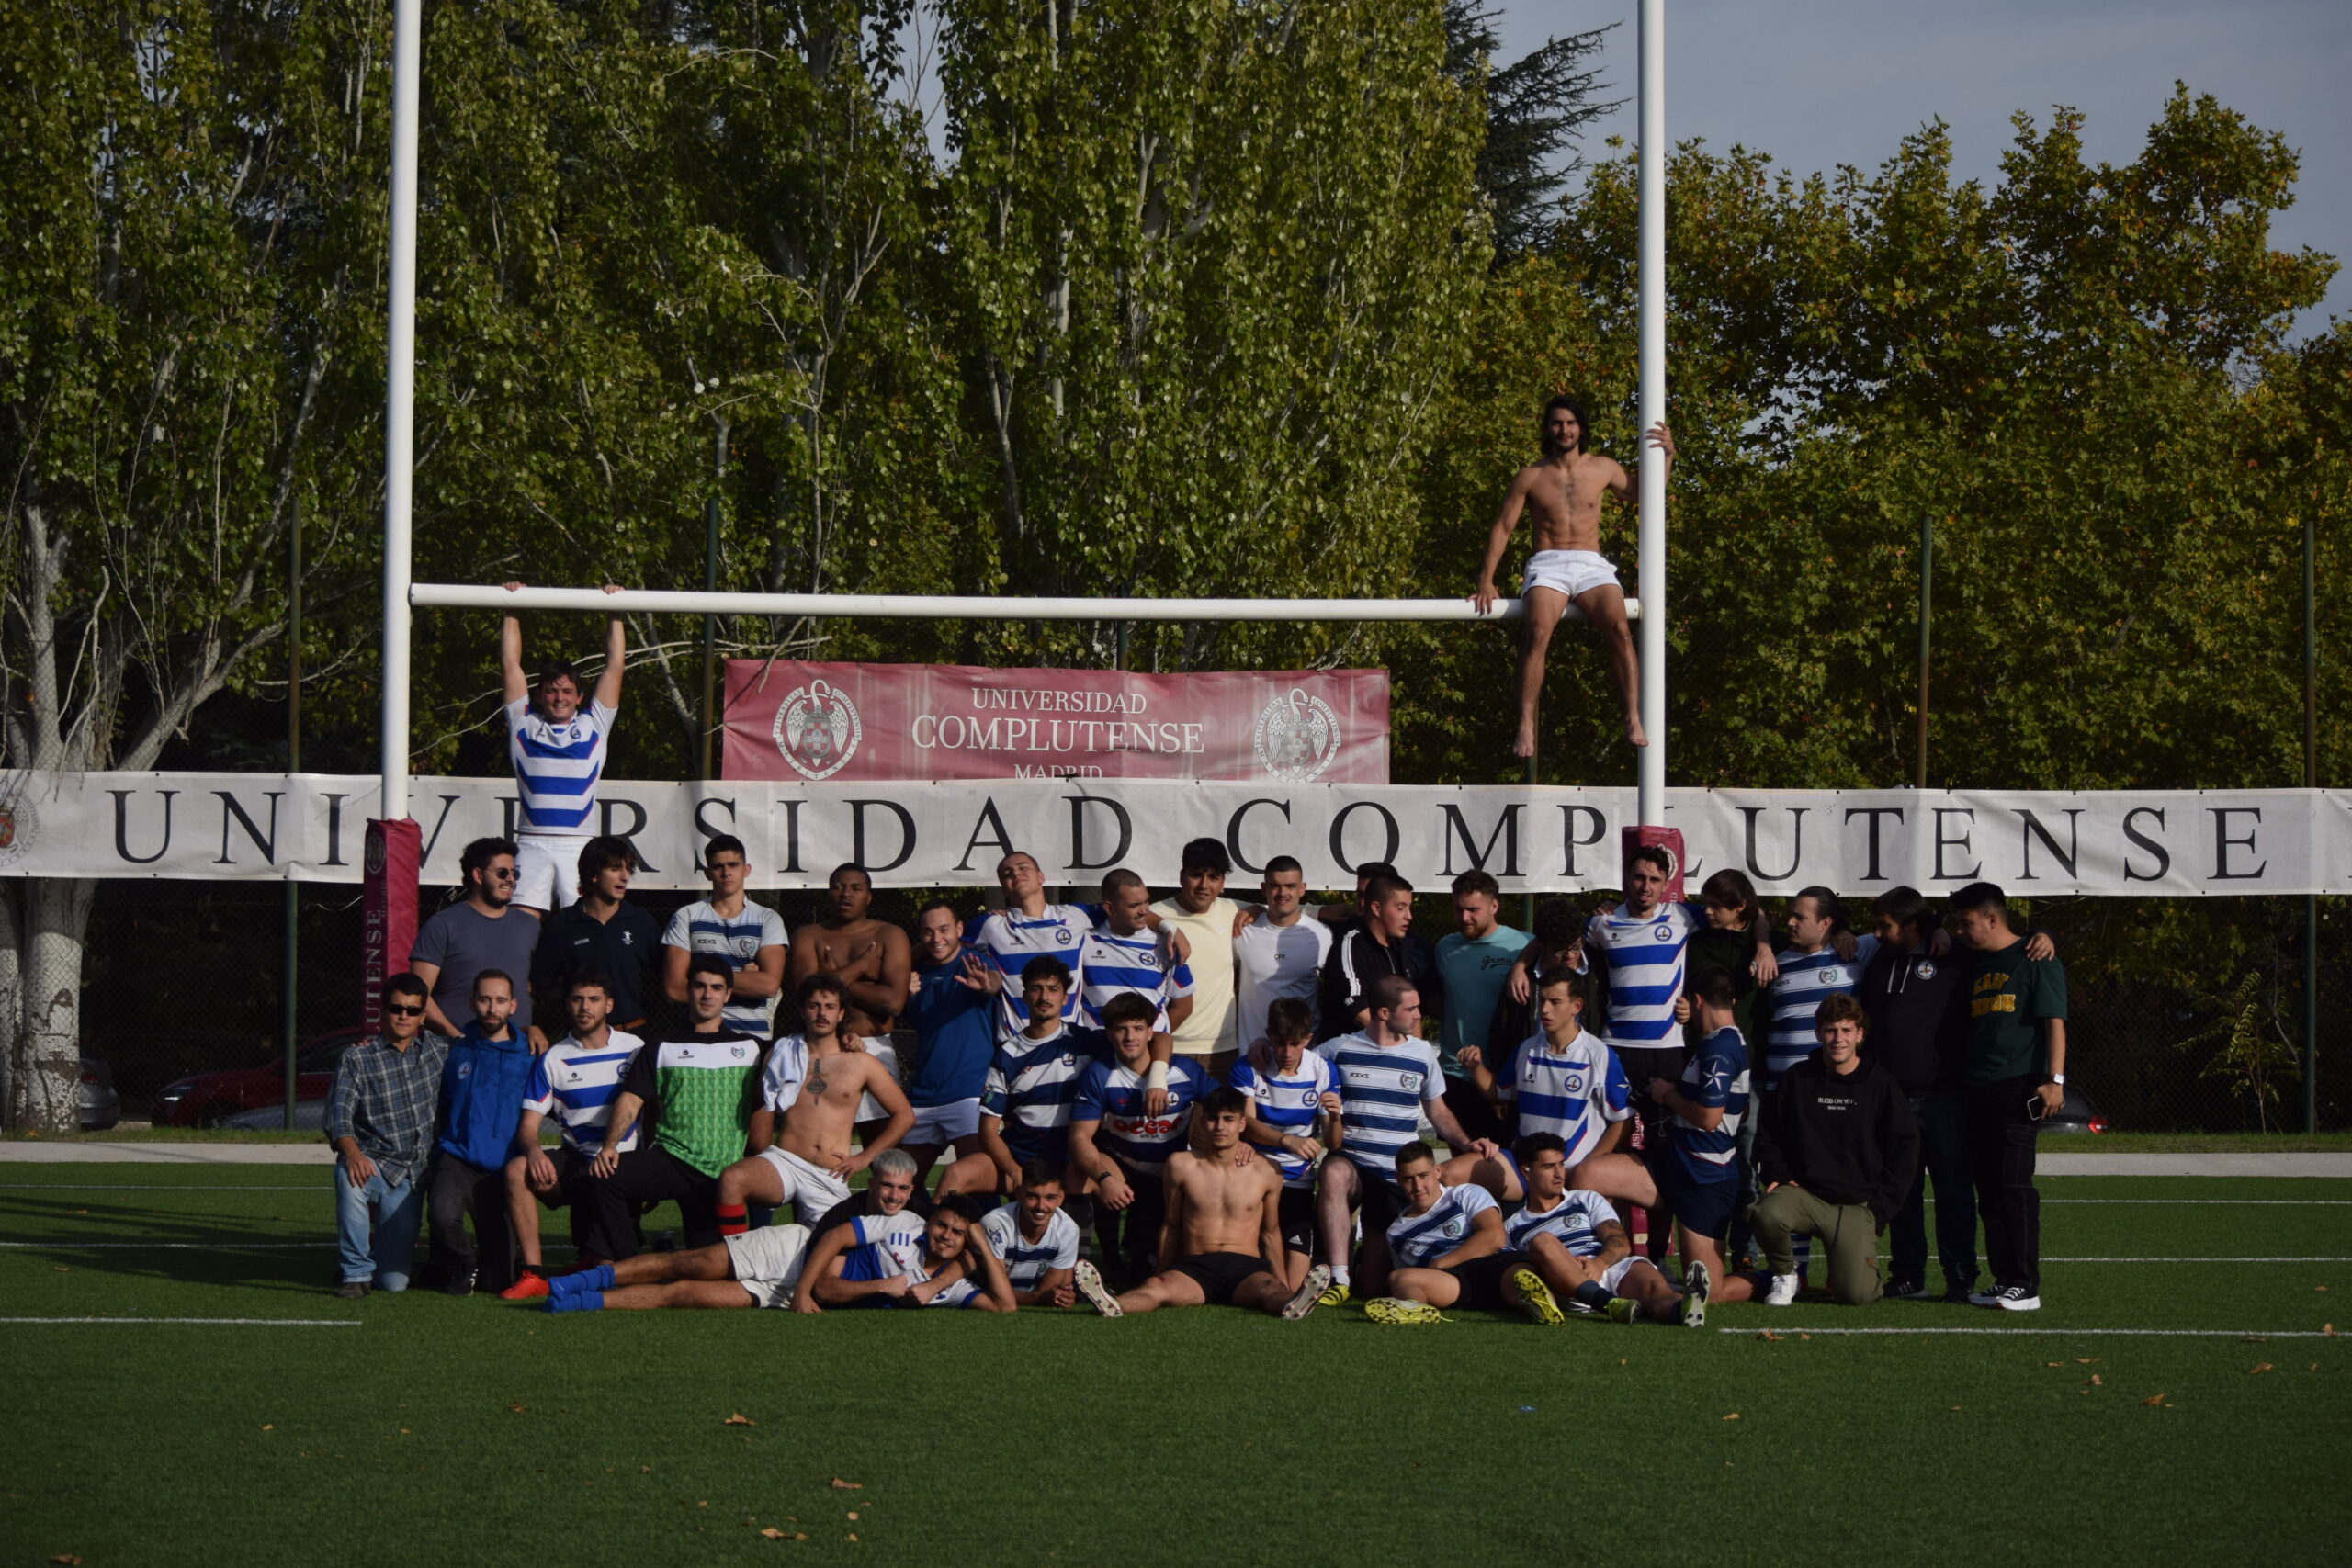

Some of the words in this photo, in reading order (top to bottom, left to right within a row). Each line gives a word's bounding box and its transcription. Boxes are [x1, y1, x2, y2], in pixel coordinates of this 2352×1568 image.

[971, 688, 1147, 715] UNIVERSIDAD
[911, 715, 1204, 753] COMPLUTENSE
[1227, 798, 2267, 882] COMPUTENSE
